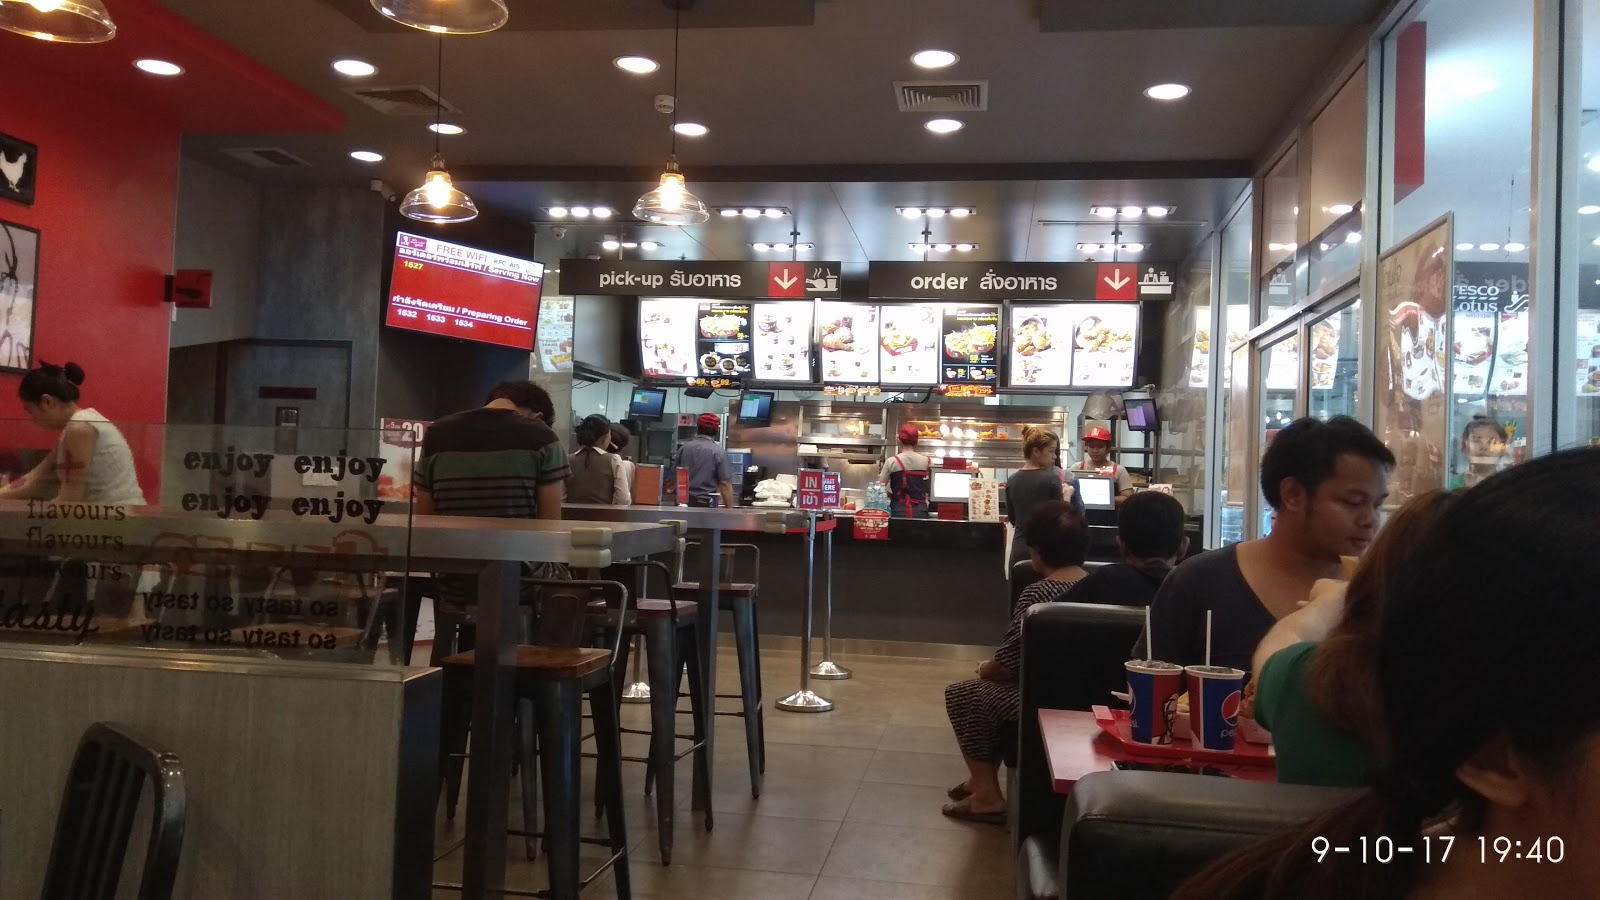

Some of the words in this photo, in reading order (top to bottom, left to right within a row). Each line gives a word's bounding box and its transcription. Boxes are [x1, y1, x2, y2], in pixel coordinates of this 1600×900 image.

[436, 244, 463, 258] FREE
[466, 252, 487, 262] WIFI
[403, 259, 424, 270] 1527
[488, 265, 520, 280] Serving
[521, 272, 540, 283] Now
[599, 270, 663, 288] pick-up
[669, 269, 742, 288] รับอาหาร
[910, 273, 968, 290] order
[979, 268, 1058, 290] สั่งอาหาร
[1453, 285, 1499, 296] TESCO
[1453, 299, 1498, 313] Lotus
[461, 307, 503, 323] Preparing
[504, 316, 528, 326] Order
[401, 421, 424, 443] 20
[183, 445, 275, 479] enjoy
[293, 449, 388, 483] enjoy
[805, 476, 818, 489] IN
[181, 486, 273, 520] enjoy
[290, 490, 386, 525] enjoy
[802, 492, 818, 506] เข้า
[27, 499, 126, 522] flavours
[26, 526, 124, 551] flavours
